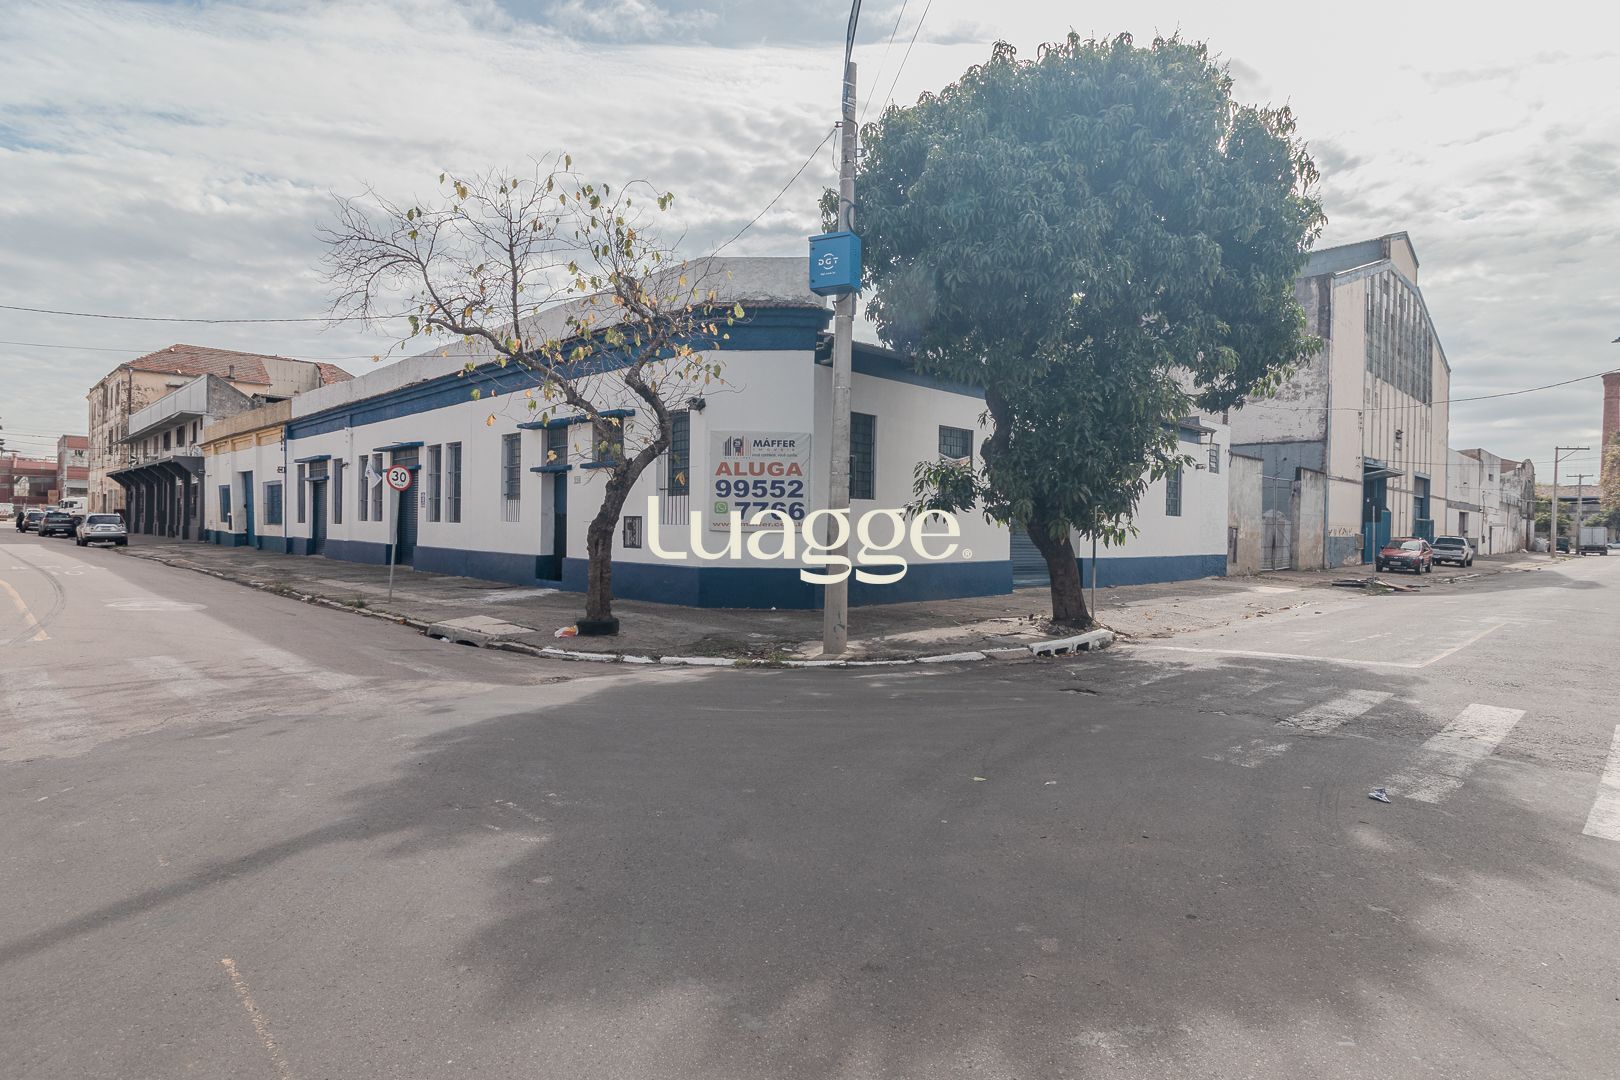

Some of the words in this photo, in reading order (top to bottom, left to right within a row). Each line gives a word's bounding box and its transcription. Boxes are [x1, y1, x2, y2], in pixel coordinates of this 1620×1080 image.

[753, 437, 796, 448] MÁFFER
[715, 461, 803, 477] ALUGA
[391, 471, 406, 482] 30
[715, 479, 804, 498] 99552
